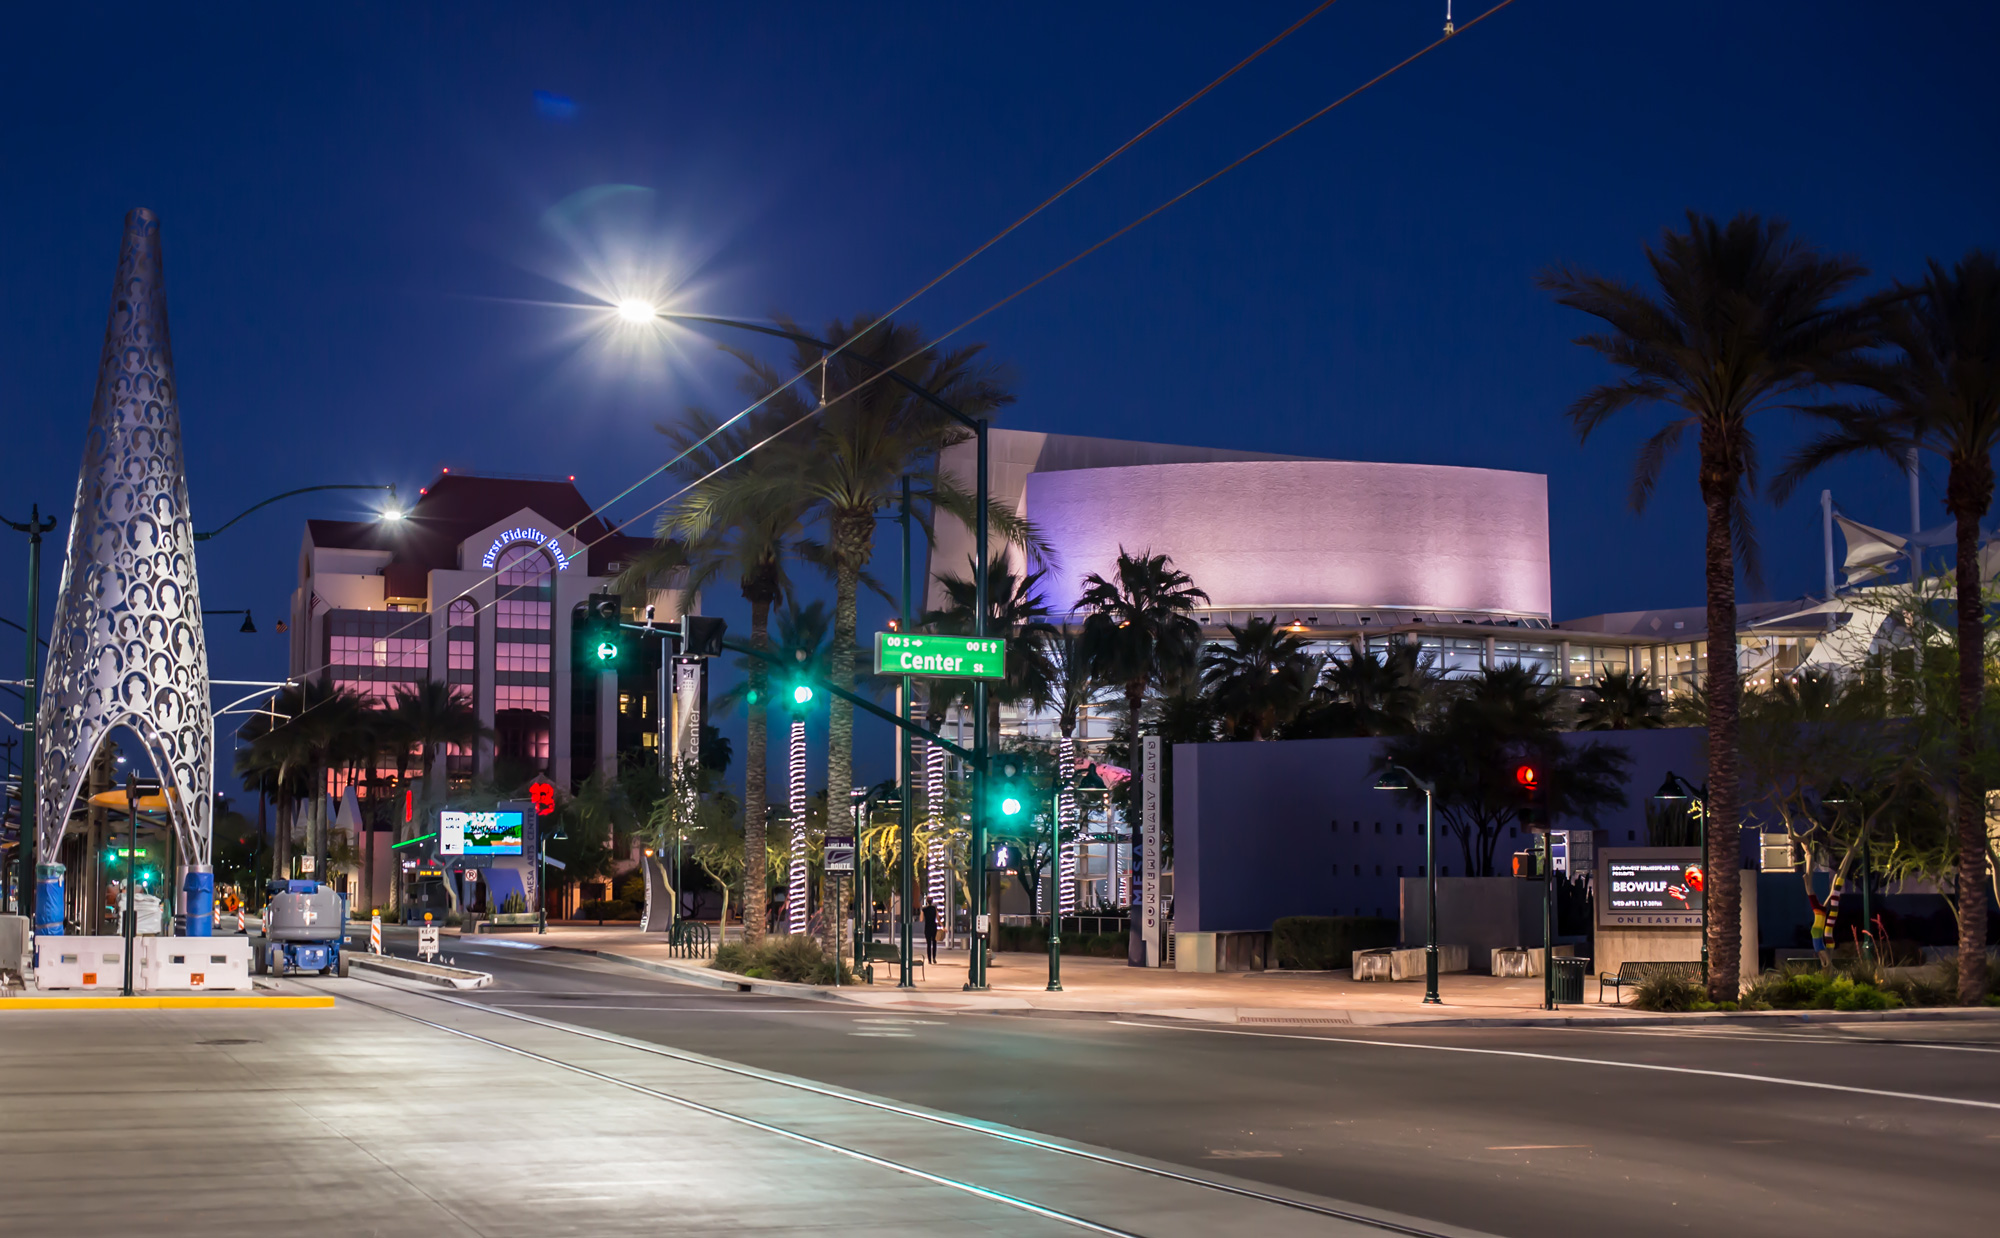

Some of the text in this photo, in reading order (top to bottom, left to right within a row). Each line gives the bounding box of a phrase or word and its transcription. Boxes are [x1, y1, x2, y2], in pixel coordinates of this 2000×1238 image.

[482, 528, 569, 571] First Fidelity Bank
[887, 636, 910, 648] 00 S
[900, 652, 984, 673] Center St
[966, 641, 988, 652] 00 E
[689, 708, 700, 754] center
[526, 807, 535, 894] MESA ARTS CENTER
[1147, 741, 1156, 928] CONTEMPORARY ARTS
[1133, 843, 1143, 906] MESA
[1613, 881, 1668, 892] BEOWULF
